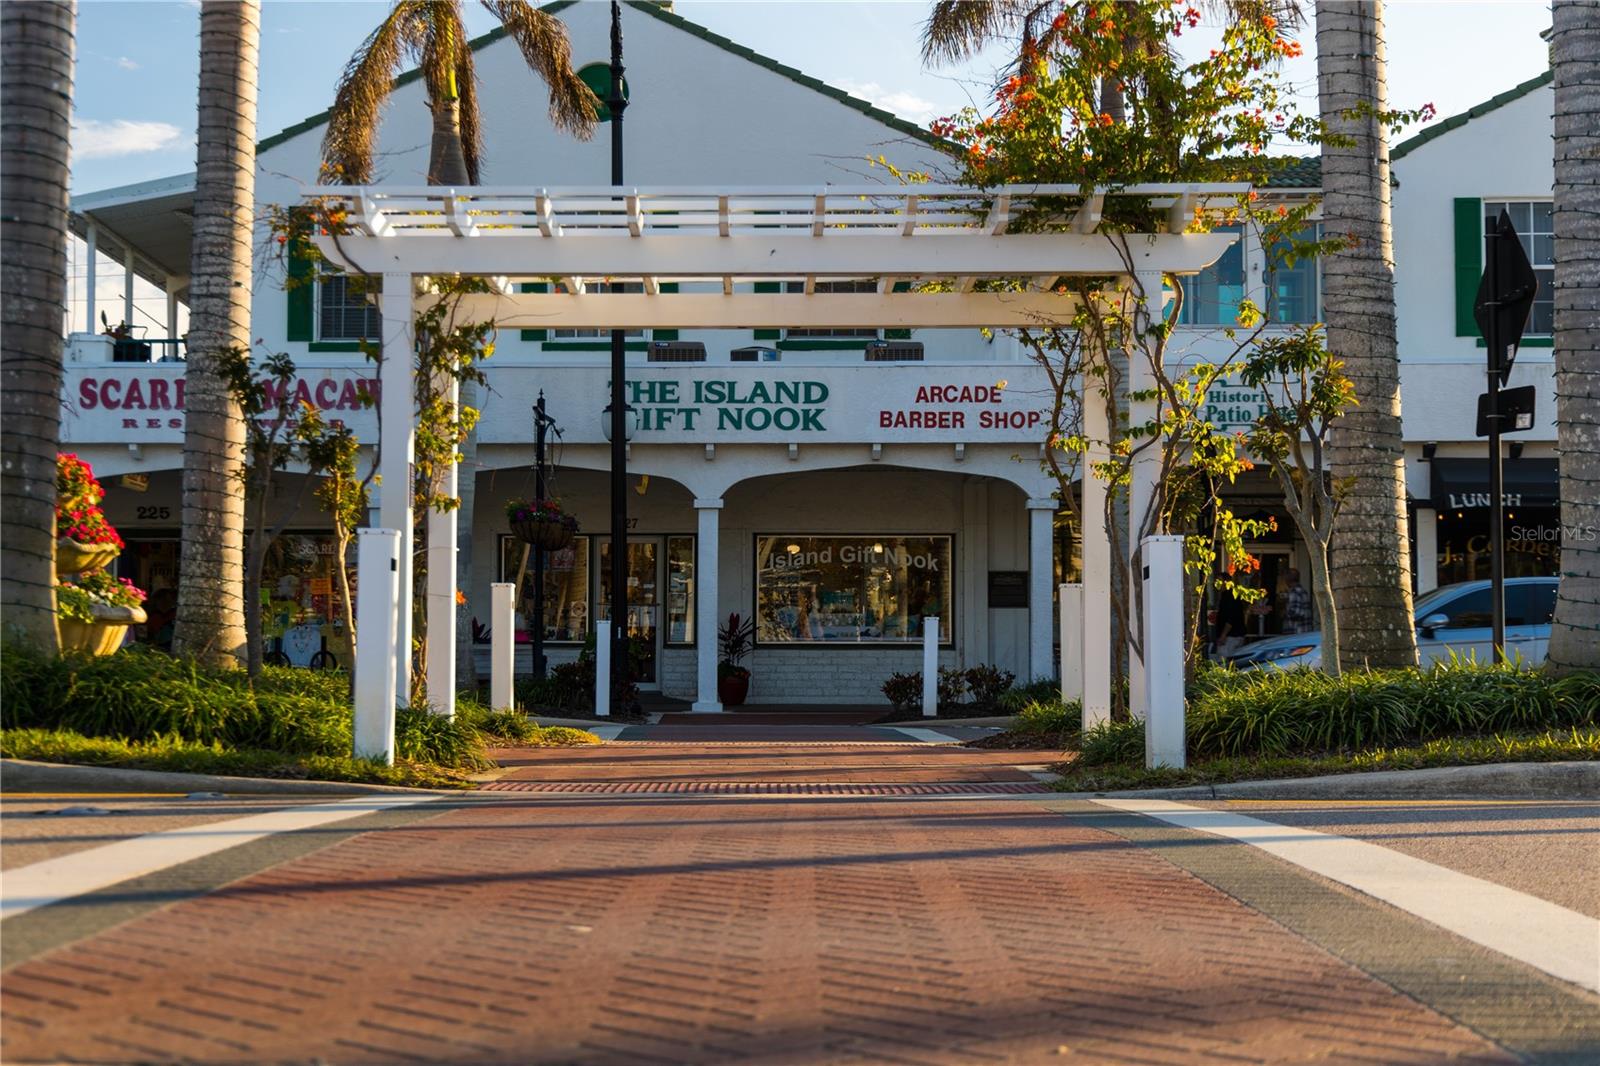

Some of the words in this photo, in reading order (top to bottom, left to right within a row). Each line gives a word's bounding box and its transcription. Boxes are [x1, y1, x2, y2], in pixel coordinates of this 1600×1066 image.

[693, 380, 829, 404] ISLAND
[916, 385, 1002, 403] ARCADE
[717, 407, 827, 431] NOOK
[879, 410, 964, 429] BARBER
[979, 410, 1041, 429] SHOP
[1206, 405, 1251, 422] Patio
[137, 506, 171, 520] 225
[769, 546, 832, 569] Island
[839, 545, 878, 564] Gift
